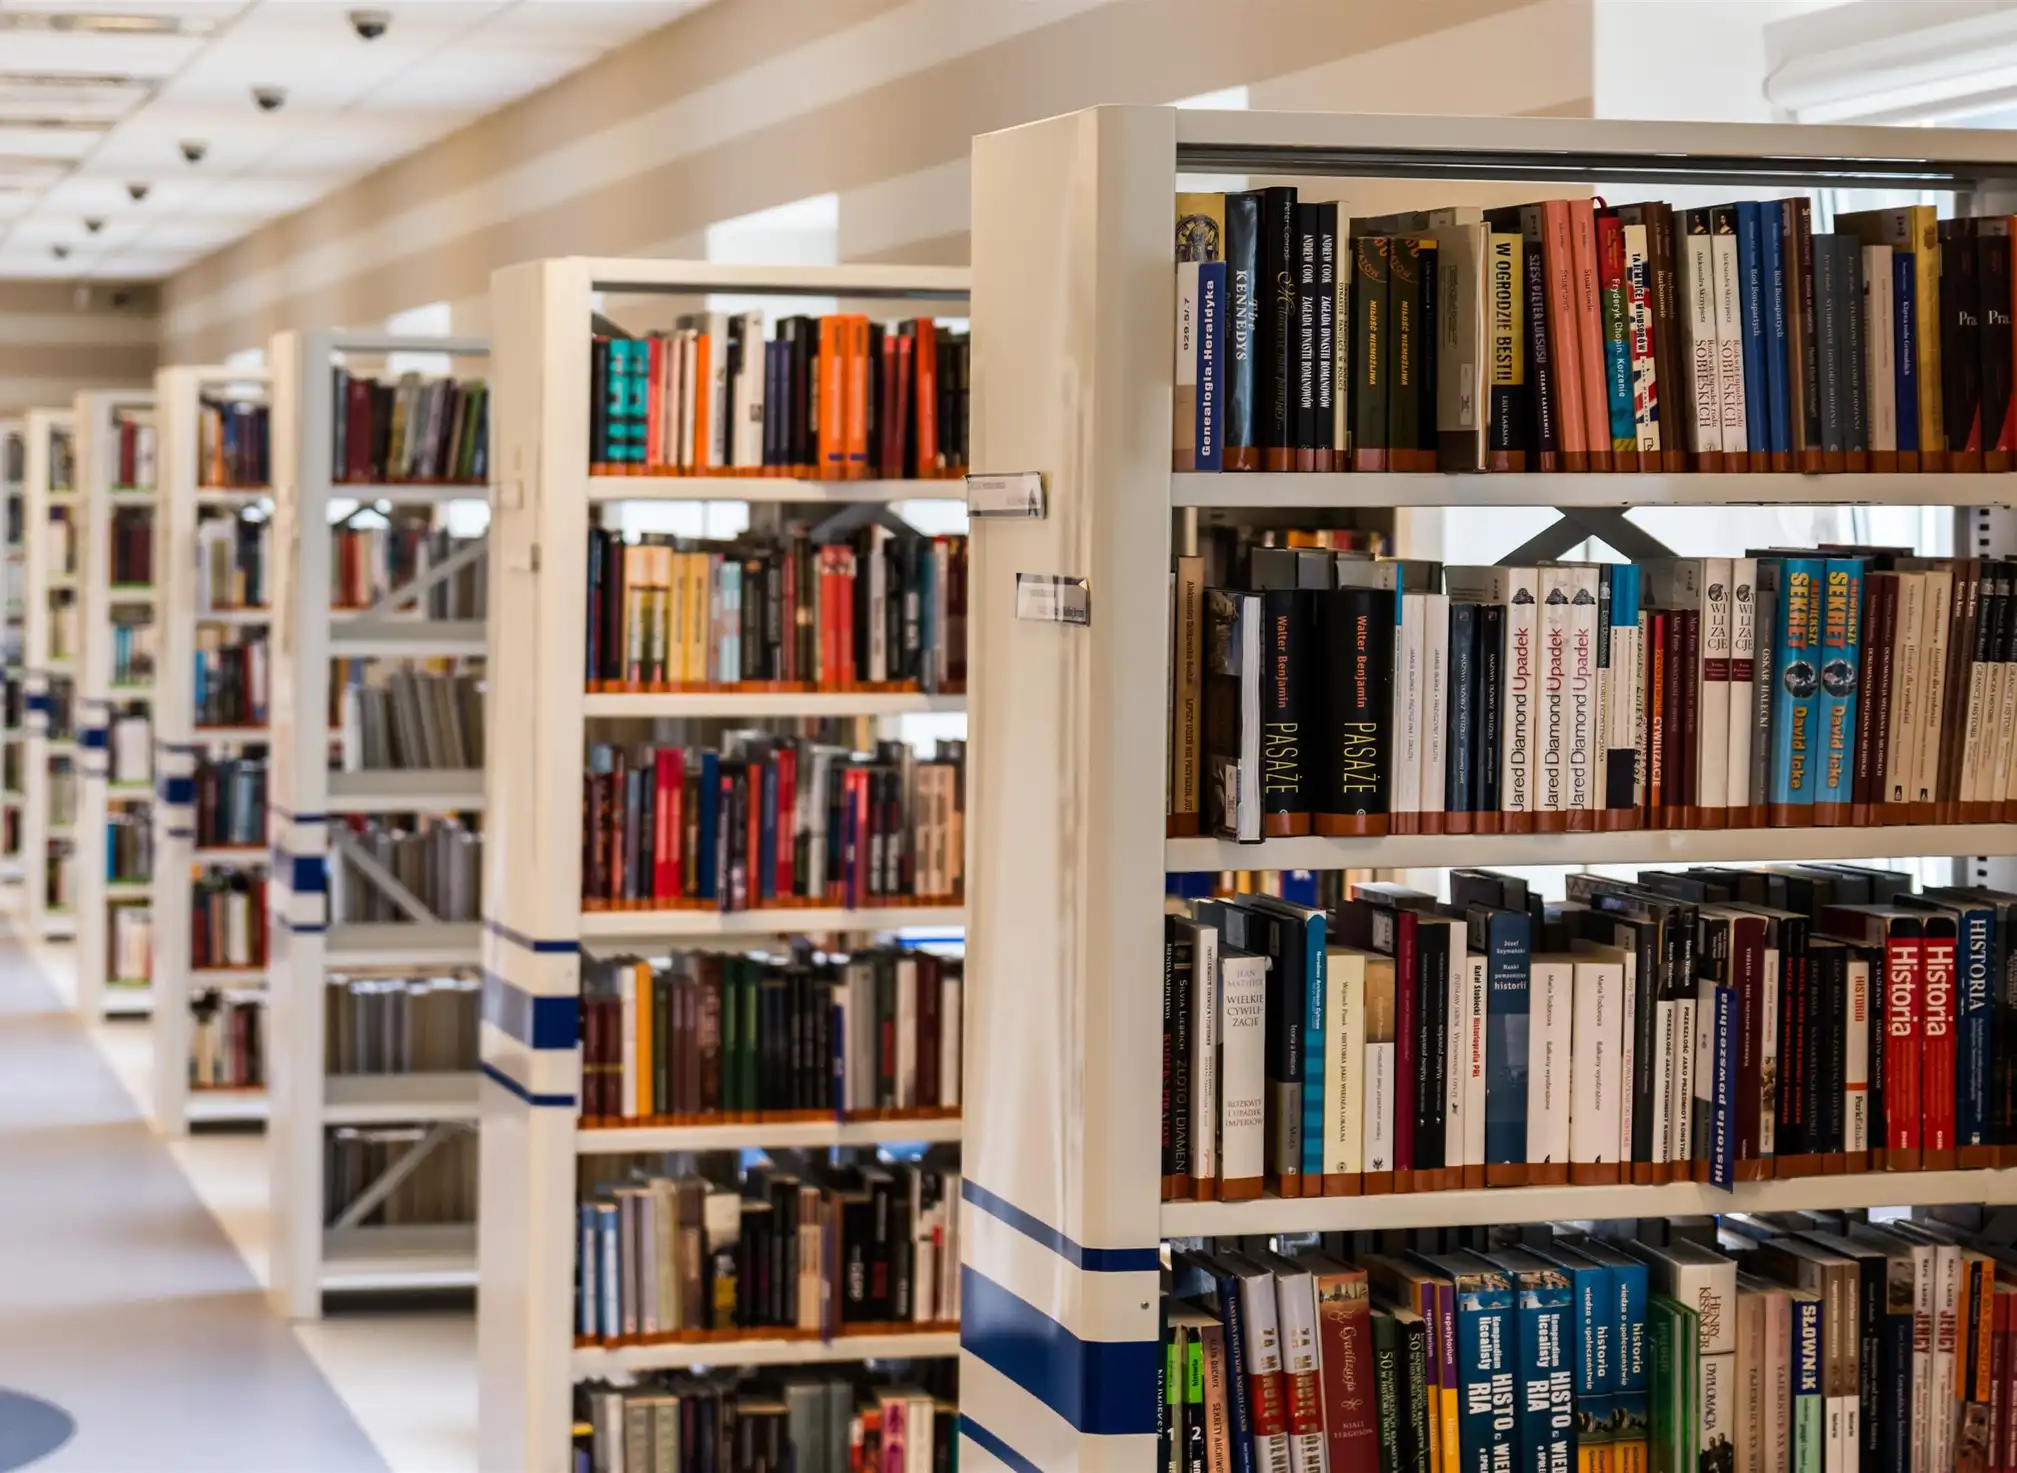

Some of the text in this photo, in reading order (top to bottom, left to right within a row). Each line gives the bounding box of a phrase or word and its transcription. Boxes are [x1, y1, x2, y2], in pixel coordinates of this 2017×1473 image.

[1302, 234, 1313, 283] ANDREW COOK
[1322, 234, 1332, 283] ANDREW COOK
[1632, 254, 1645, 298] TAJEMNICE
[1236, 270, 1247, 360] KENNEDYS
[1496, 243, 1512, 380] W OGRODZIE BESTII
[1657, 270, 1667, 318] Burbonowie
[1301, 329, 1312, 359] DYNASTII
[1320, 328, 1331, 359] DYNASTII
[1610, 279, 1622, 319] Fryderyk
[1616, 358, 1626, 397] Korzenie
[1540, 370, 1548, 395] CEZARY
[1695, 340, 1710, 427] SOBIESKICH
[1721, 340, 1736, 428] SOBIESKICH
[1711, 627, 1725, 637] ZA
[1738, 628, 1751, 638] ZA
[1787, 572, 1809, 650] SEKRET
[1825, 571, 1847, 649] SEKRET
[1276, 616, 1288, 708] Walter Benjamin
[1355, 616, 1367, 708] Walter Benjamin
[1708, 638, 1728, 651] CJE
[1735, 639, 1753, 651] CJE
[1759, 648, 1771, 728] OSKAR HALECKI
[1511, 628, 1531, 812] Jared Diamond Upadek
[1544, 628, 1565, 811] Jared Diamond Upadek
[1570, 628, 1592, 811] Jared Diamond Upadek
[1828, 704, 1846, 788] David Icke
[1265, 723, 1303, 794] PASAŻE
[1344, 722, 1380, 793] PASAŻE
[1652, 716, 1662, 787] CYWILIZACJE
[1790, 706, 1806, 789] David Icke
[1472, 965, 1483, 1016] Rafał Stobiecki
[1495, 982, 1526, 990] historii
[1891, 946, 1918, 1036] Historia
[1926, 946, 1954, 1036] Historia
[1969, 919, 1986, 1012] HISTORIA
[1178, 979, 1188, 1007] SILVIA
[1854, 976, 1865, 1022] HISTORIA
[1233, 1017, 1259, 1027] ZACJE
[1471, 1017, 1481, 1078] Historiografia PRL
[1289, 1051, 1297, 1075] historia
[1714, 992, 1729, 1182] Historia powszechna
[1585, 1287, 1593, 1317] wiedza
[1620, 1283, 1628, 1313] wiedza
[1710, 1295, 1722, 1339] HENRY
[1340, 1326, 1357, 1392] Cywilizacja
[1426, 1309, 1434, 1357] repetytorium
[1444, 1313, 1454, 1364] repetytorium
[1477, 1317, 1492, 1370] licealisty
[1492, 1316, 1502, 1369] Kompendium
[1536, 1314, 1550, 1368] licealisty
[1550, 1314, 1560, 1367] Kompendium
[1597, 1326, 1607, 1377] historia
[1632, 1323, 1643, 1373] historia
[1380, 1352, 1393, 1369] 50
[1468, 1383, 1492, 1414] RIA
[1492, 1373, 1514, 1430] HISTO
[1527, 1380, 1550, 1412] RIA
[1550, 1371, 1572, 1429] HISTO
[1703, 1363, 1717, 1431] DYPLOMACJA
[1192, 1426, 1201, 1440] 2
